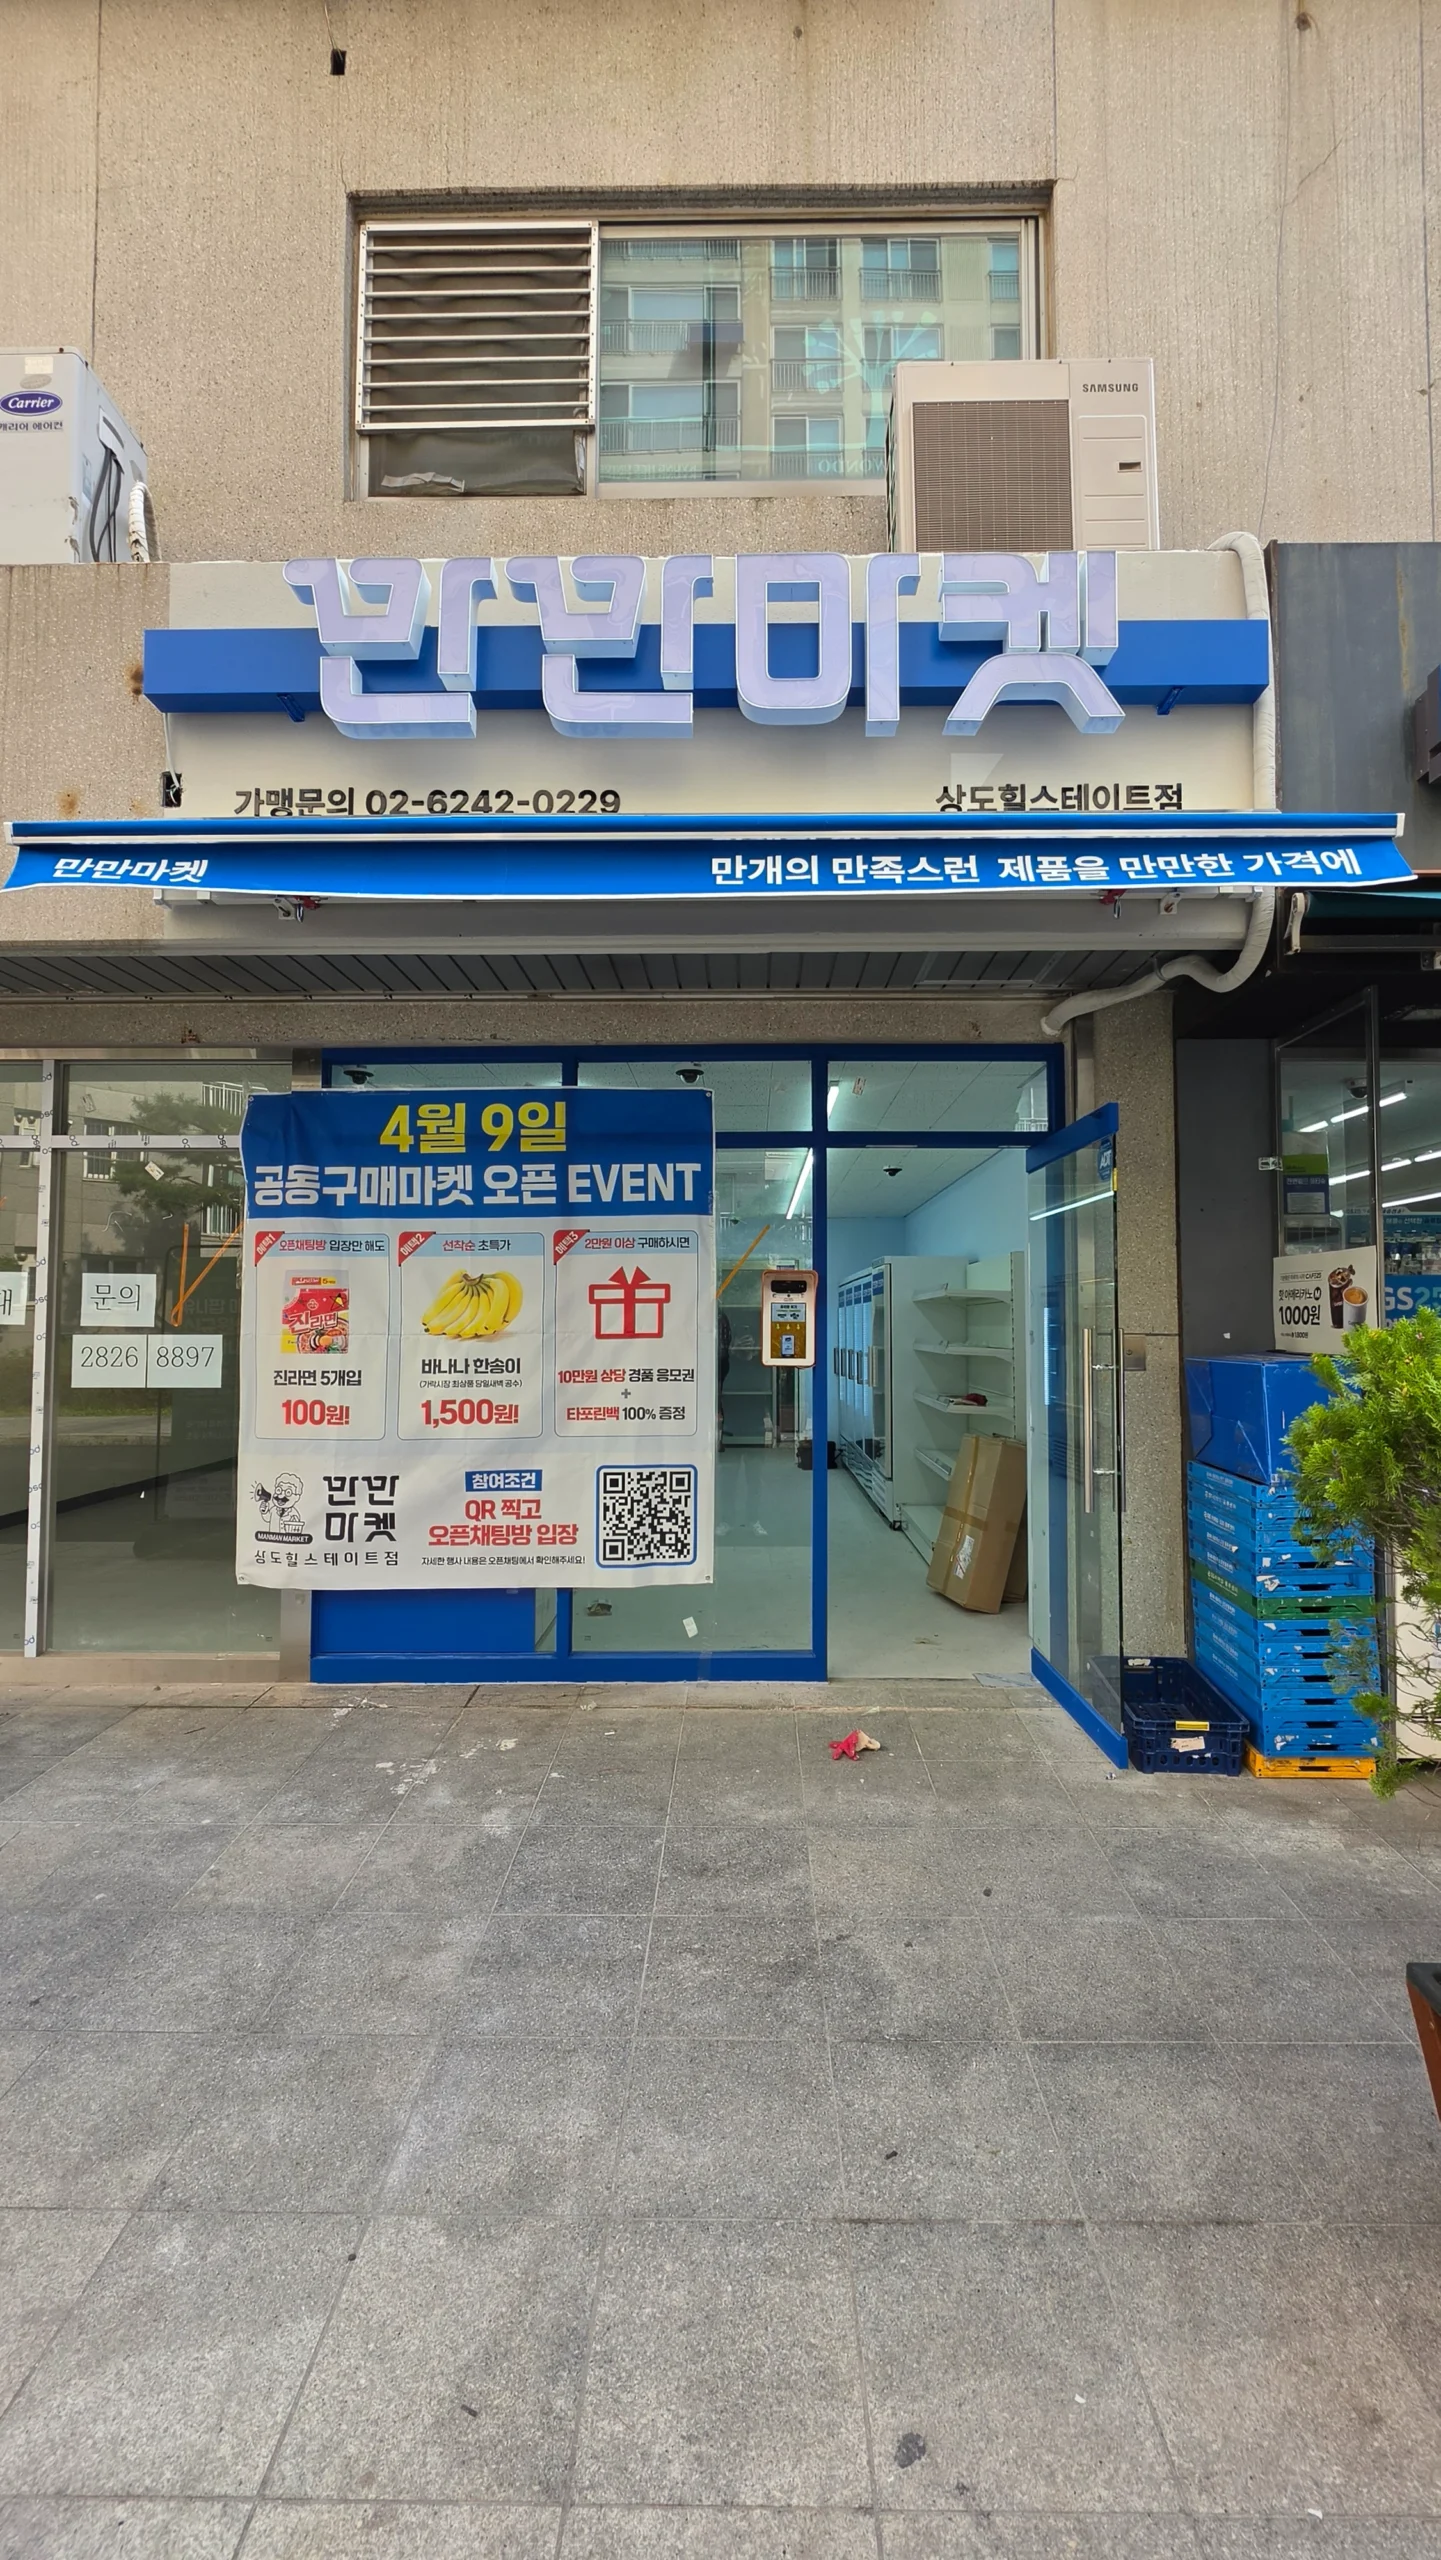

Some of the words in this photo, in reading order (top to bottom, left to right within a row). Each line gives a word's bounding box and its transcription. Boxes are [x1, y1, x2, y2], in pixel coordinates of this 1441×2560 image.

[1082, 382, 1139, 393] SAMSUNG
[8, 397, 54, 409] Carrier
[32, 421, 63, 431] 에어컨
[283, 552, 1126, 739] 만만마켓
[233, 787, 355, 816] 가맹문의
[365, 788, 622, 815] 02-6242-0229
[935, 783, 1183, 812] 상도힐스테이트점
[52, 858, 209, 883] 만만마켓
[710, 854, 819, 885] 만개의
[831, 854, 980, 885] 만족스런
[997, 854, 1110, 882] 제품을
[1120, 853, 1236, 879] 만만한
[1242, 848, 1362, 876] 가격에
[379, 1102, 466, 1153] 4월
[481, 1101, 567, 1152] 9일
[254, 1163, 473, 1206] 공동구매마켓
[484, 1164, 558, 1205] 오픈
[568, 1163, 701, 1205] EVENT
[279, 1239, 327, 1251] 오픈채팅방
[329, 1240, 362, 1252] 입장만
[364, 1240, 385, 1251] 해도
[442, 1240, 475, 1252] 선착순
[478, 1239, 511, 1251] 초특가
[584, 1237, 612, 1249] 2만원
[614, 1237, 635, 1248] 이상
[637, 1237, 690, 1249] 구매하시면
[90, 1284, 141, 1311] 문의
[1285, 1287, 1313, 1300] 아메리카노
[288, 1311, 338, 1333] 진라면
[1278, 1305, 1321, 1326] 1000원
[81, 1346, 139, 1368] 2826
[156, 1346, 215, 1368] 8897
[421, 1358, 470, 1374] 바나나
[473, 1357, 521, 1374] 한송이
[273, 1369, 317, 1386] 진라면
[320, 1369, 362, 1386] 5개입
[419, 1379, 450, 1388] (가락시장
[452, 1379, 474, 1388] 최상품
[475, 1379, 503, 1388] 당일새벽
[505, 1379, 523, 1388] 공수)
[558, 1369, 597, 1383] 10만원
[600, 1369, 626, 1383] 상당
[628, 1369, 654, 1382] 경품
[656, 1368, 694, 1382] 응모권
[282, 1399, 350, 1426] 100원!
[421, 1398, 519, 1428] 1,500원!
[566, 1407, 620, 1421] 타포린백
[622, 1406, 656, 1420] 100%
[659, 1406, 685, 1420] 증정
[323, 1475, 399, 1506] 만만
[472, 1472, 536, 1490] 참여조건
[465, 1499, 496, 1522] QR
[501, 1499, 542, 1520] 찍고
[257, 1533, 283, 1542] MANMAN
[283, 1534, 309, 1543] MARKET
[325, 1512, 397, 1543] 마켓
[428, 1524, 532, 1546] 오픈채팅방
[536, 1524, 579, 1546] 입장
[421, 1556, 445, 1566] 자세한
[446, 1556, 462, 1566] 행사
[463, 1556, 487, 1565] 내용은
[488, 1556, 535, 1565] 오픈채팅에서
[535, 1555, 586, 1565] 확인해주세요!
